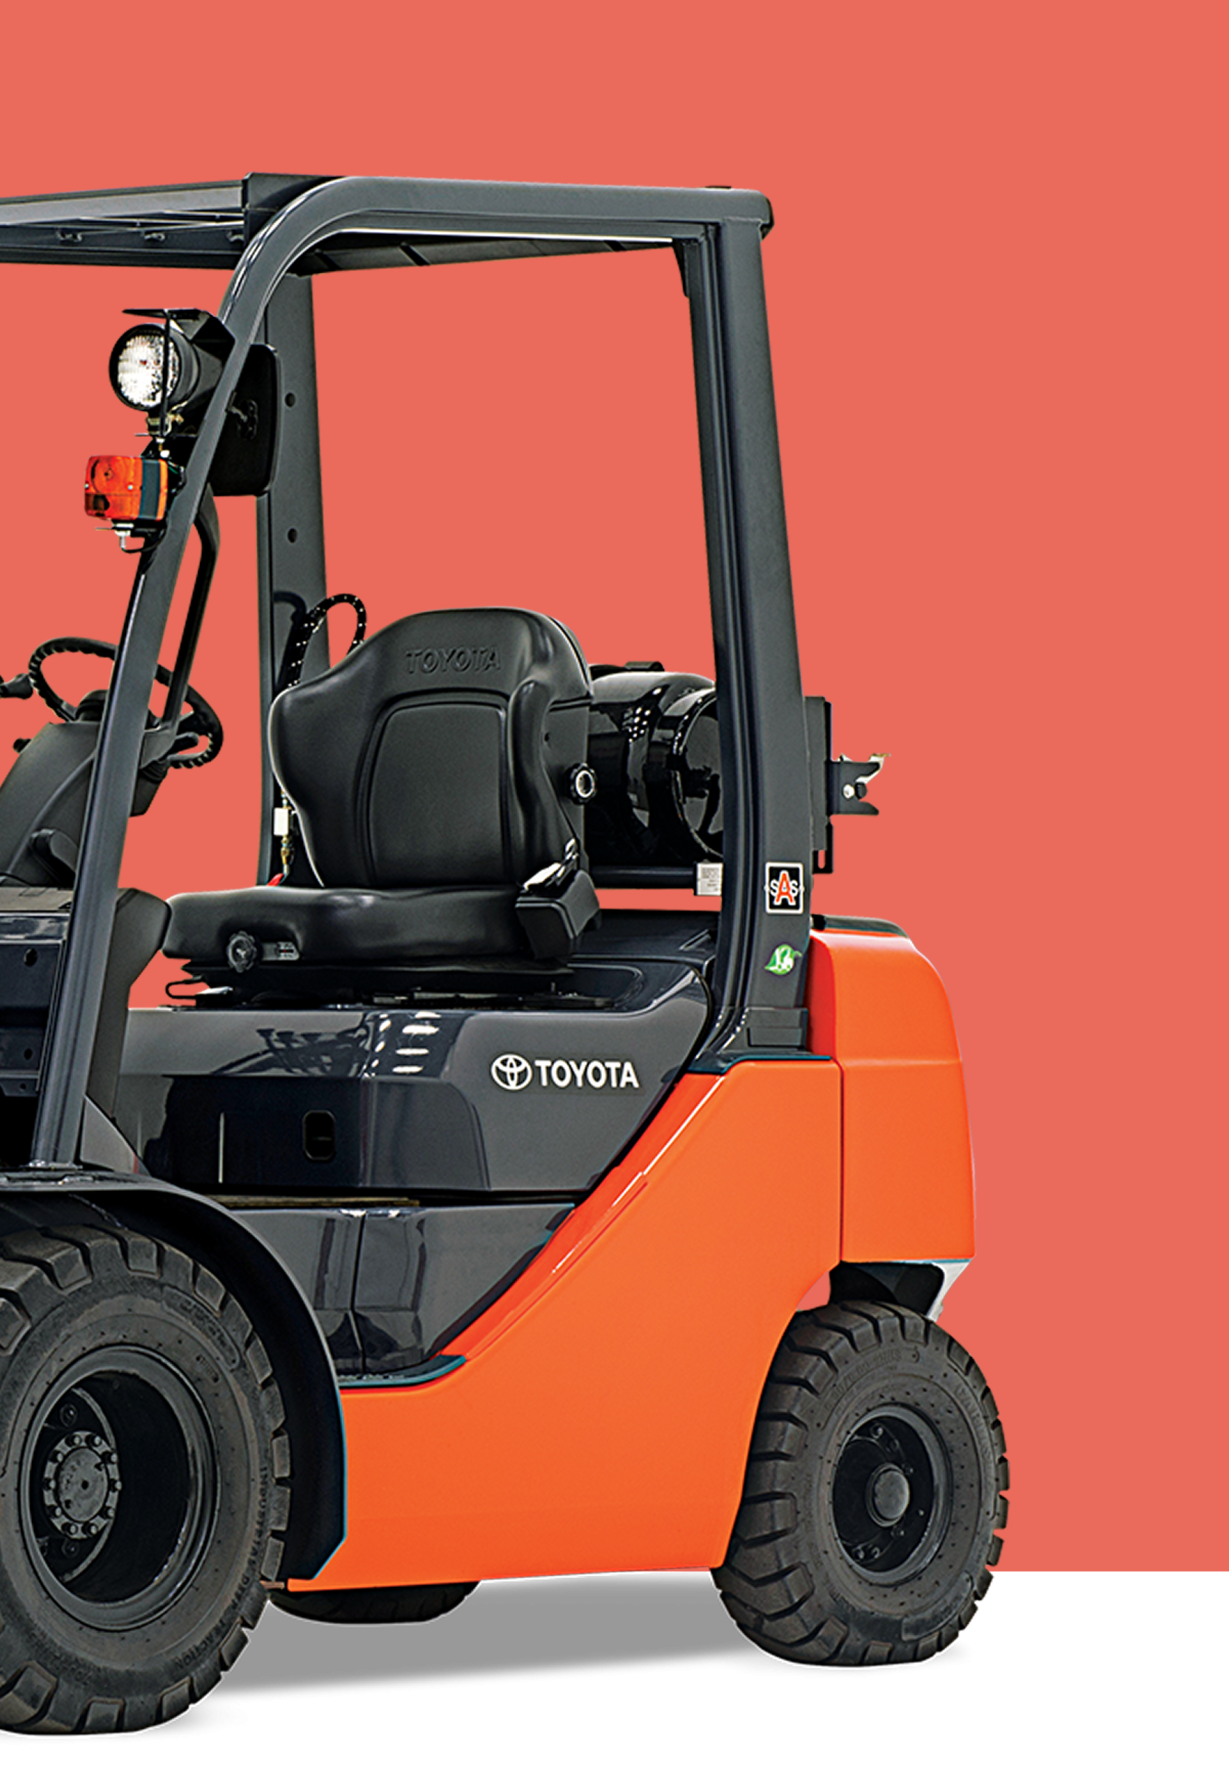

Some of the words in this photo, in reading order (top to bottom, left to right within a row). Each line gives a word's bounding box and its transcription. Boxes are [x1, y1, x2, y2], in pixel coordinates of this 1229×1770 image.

[405, 647, 502, 675] TOYOTA
[534, 1059, 640, 1089] TOYOTA
[174, 1617, 228, 1670] TRACTION
